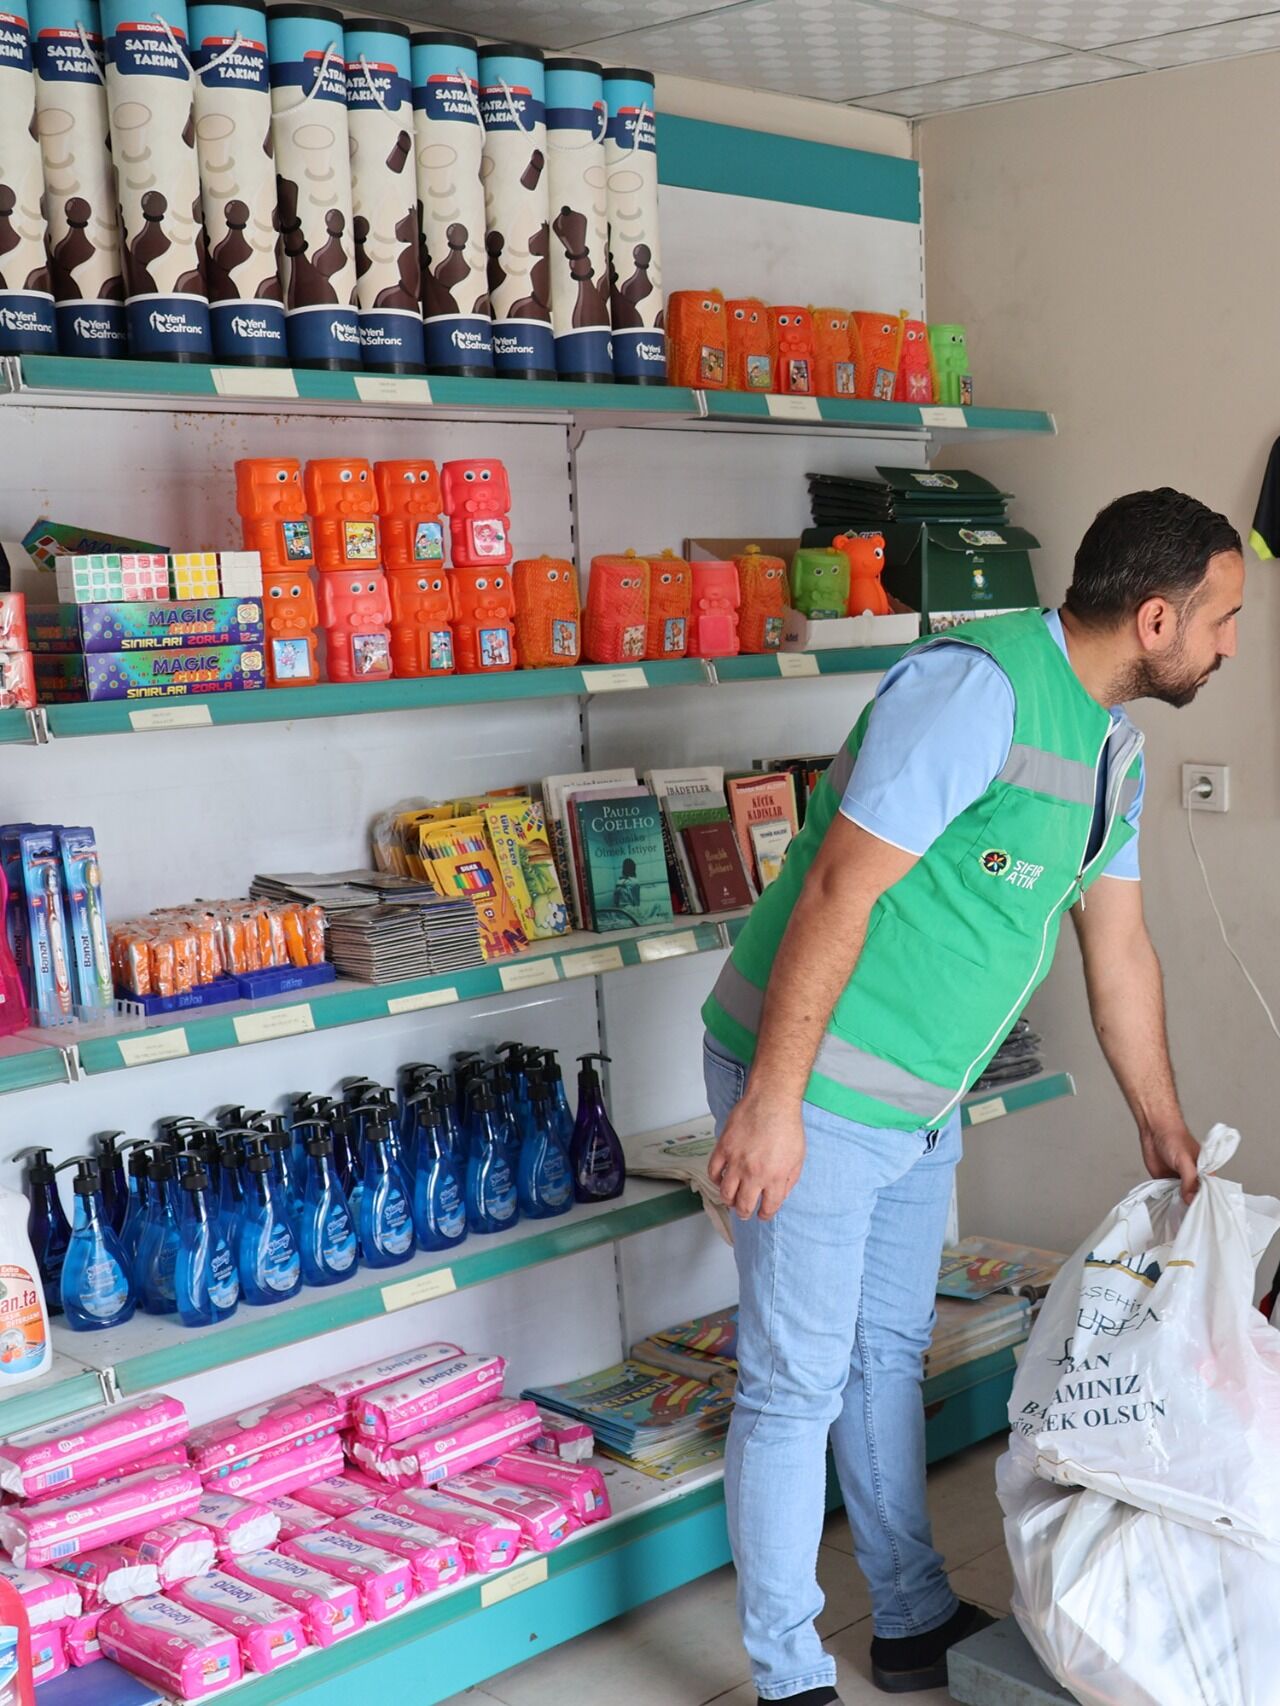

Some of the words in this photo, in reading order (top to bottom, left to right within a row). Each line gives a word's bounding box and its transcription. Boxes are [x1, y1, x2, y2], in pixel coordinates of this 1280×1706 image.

[0, 29, 27, 48] RANÇ
[0, 44, 23, 60] KIMI
[134, 53, 178, 69] TAKIMI
[218, 66, 260, 82] TAKIMI
[15, 309, 37, 321] Yeni
[164, 313, 187, 324] Yeni
[90, 319, 111, 330] Yeni
[247, 319, 267, 329] Yeni
[366, 327, 385, 337] Yeni
[464, 332, 481, 342] Yeni
[500, 336, 517, 346] Yeni
[149, 607, 216, 626] MAGIC
[121, 637, 182, 650] SINIRLARI
[187, 634, 230, 645] ZORLA
[153, 655, 220, 674] MAGIC
[127, 684, 187, 699] SINIRLARI
[191, 681, 234, 693] ZORLA
[602, 806, 640, 818] PAULO
[747, 810, 783, 821] KADINLAR
[591, 816, 655, 833] COELHO
[1012, 859, 1044, 878] SIFIR
[1005, 870, 1037, 891] ATIK
[82, 935, 93, 968] Banat
[1064, 1352, 1113, 1375] BAN
[1083, 1399, 1168, 1428] OLSUN
[210, 1578, 257, 1603] gizlady
[152, 1600, 195, 1626] gizlady
